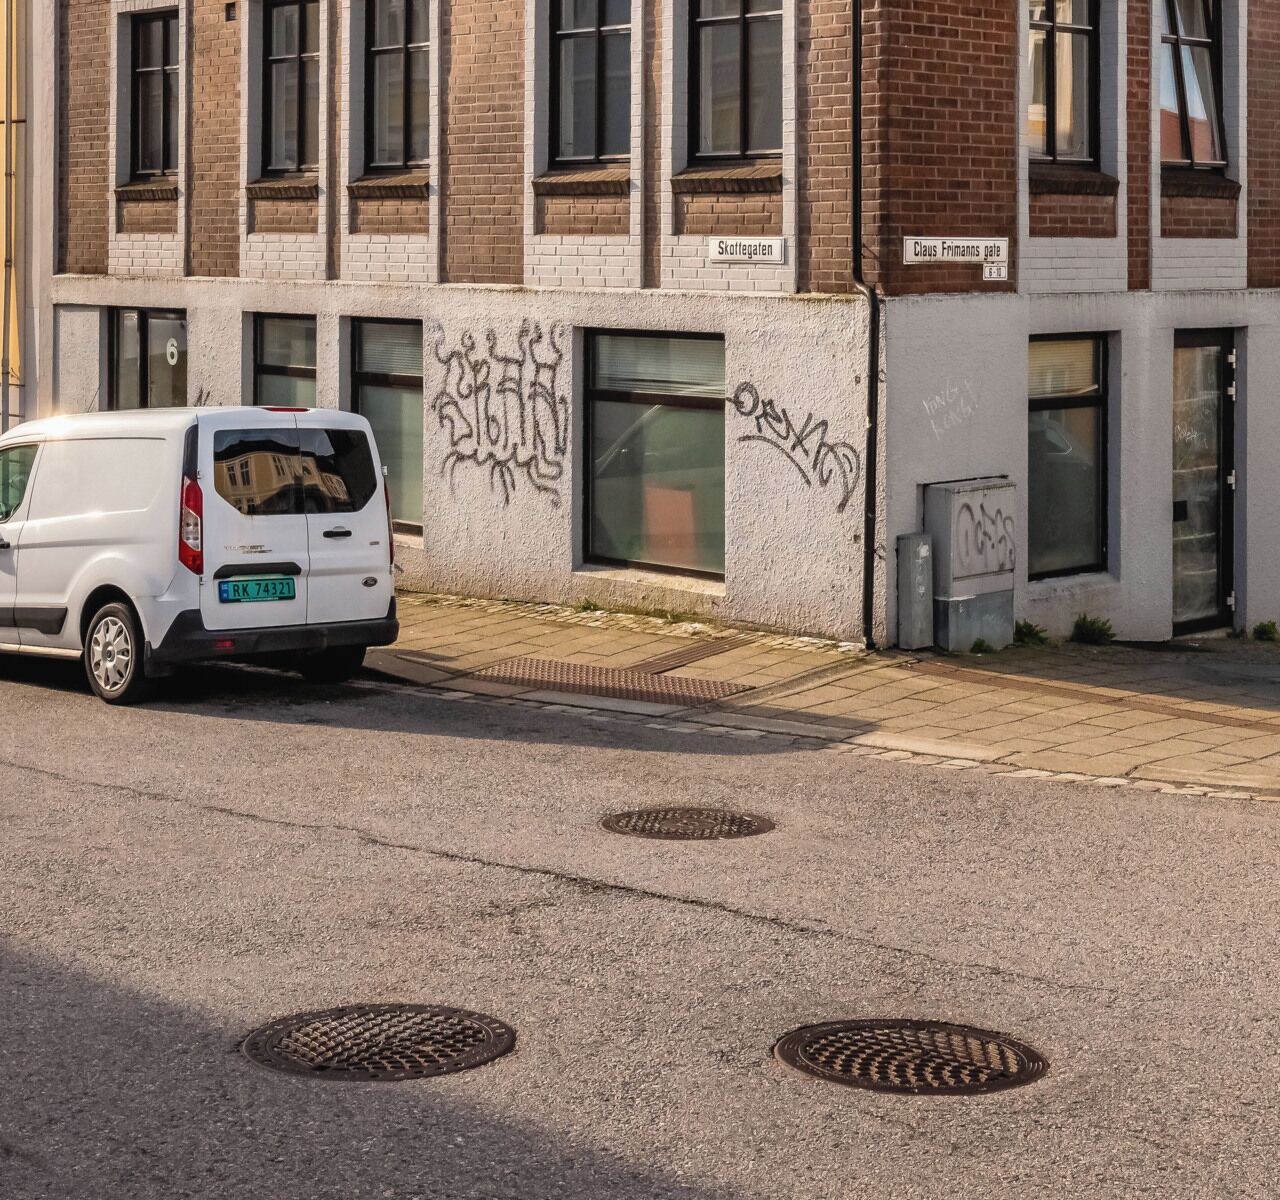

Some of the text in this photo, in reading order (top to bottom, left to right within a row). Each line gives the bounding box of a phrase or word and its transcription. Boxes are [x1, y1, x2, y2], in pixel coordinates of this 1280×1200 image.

[718, 240, 773, 259] Skottegaten
[914, 241, 1001, 260] Claus Frimanns gate
[166, 337, 178, 366] 6
[232, 582, 292, 597] RK 74321
